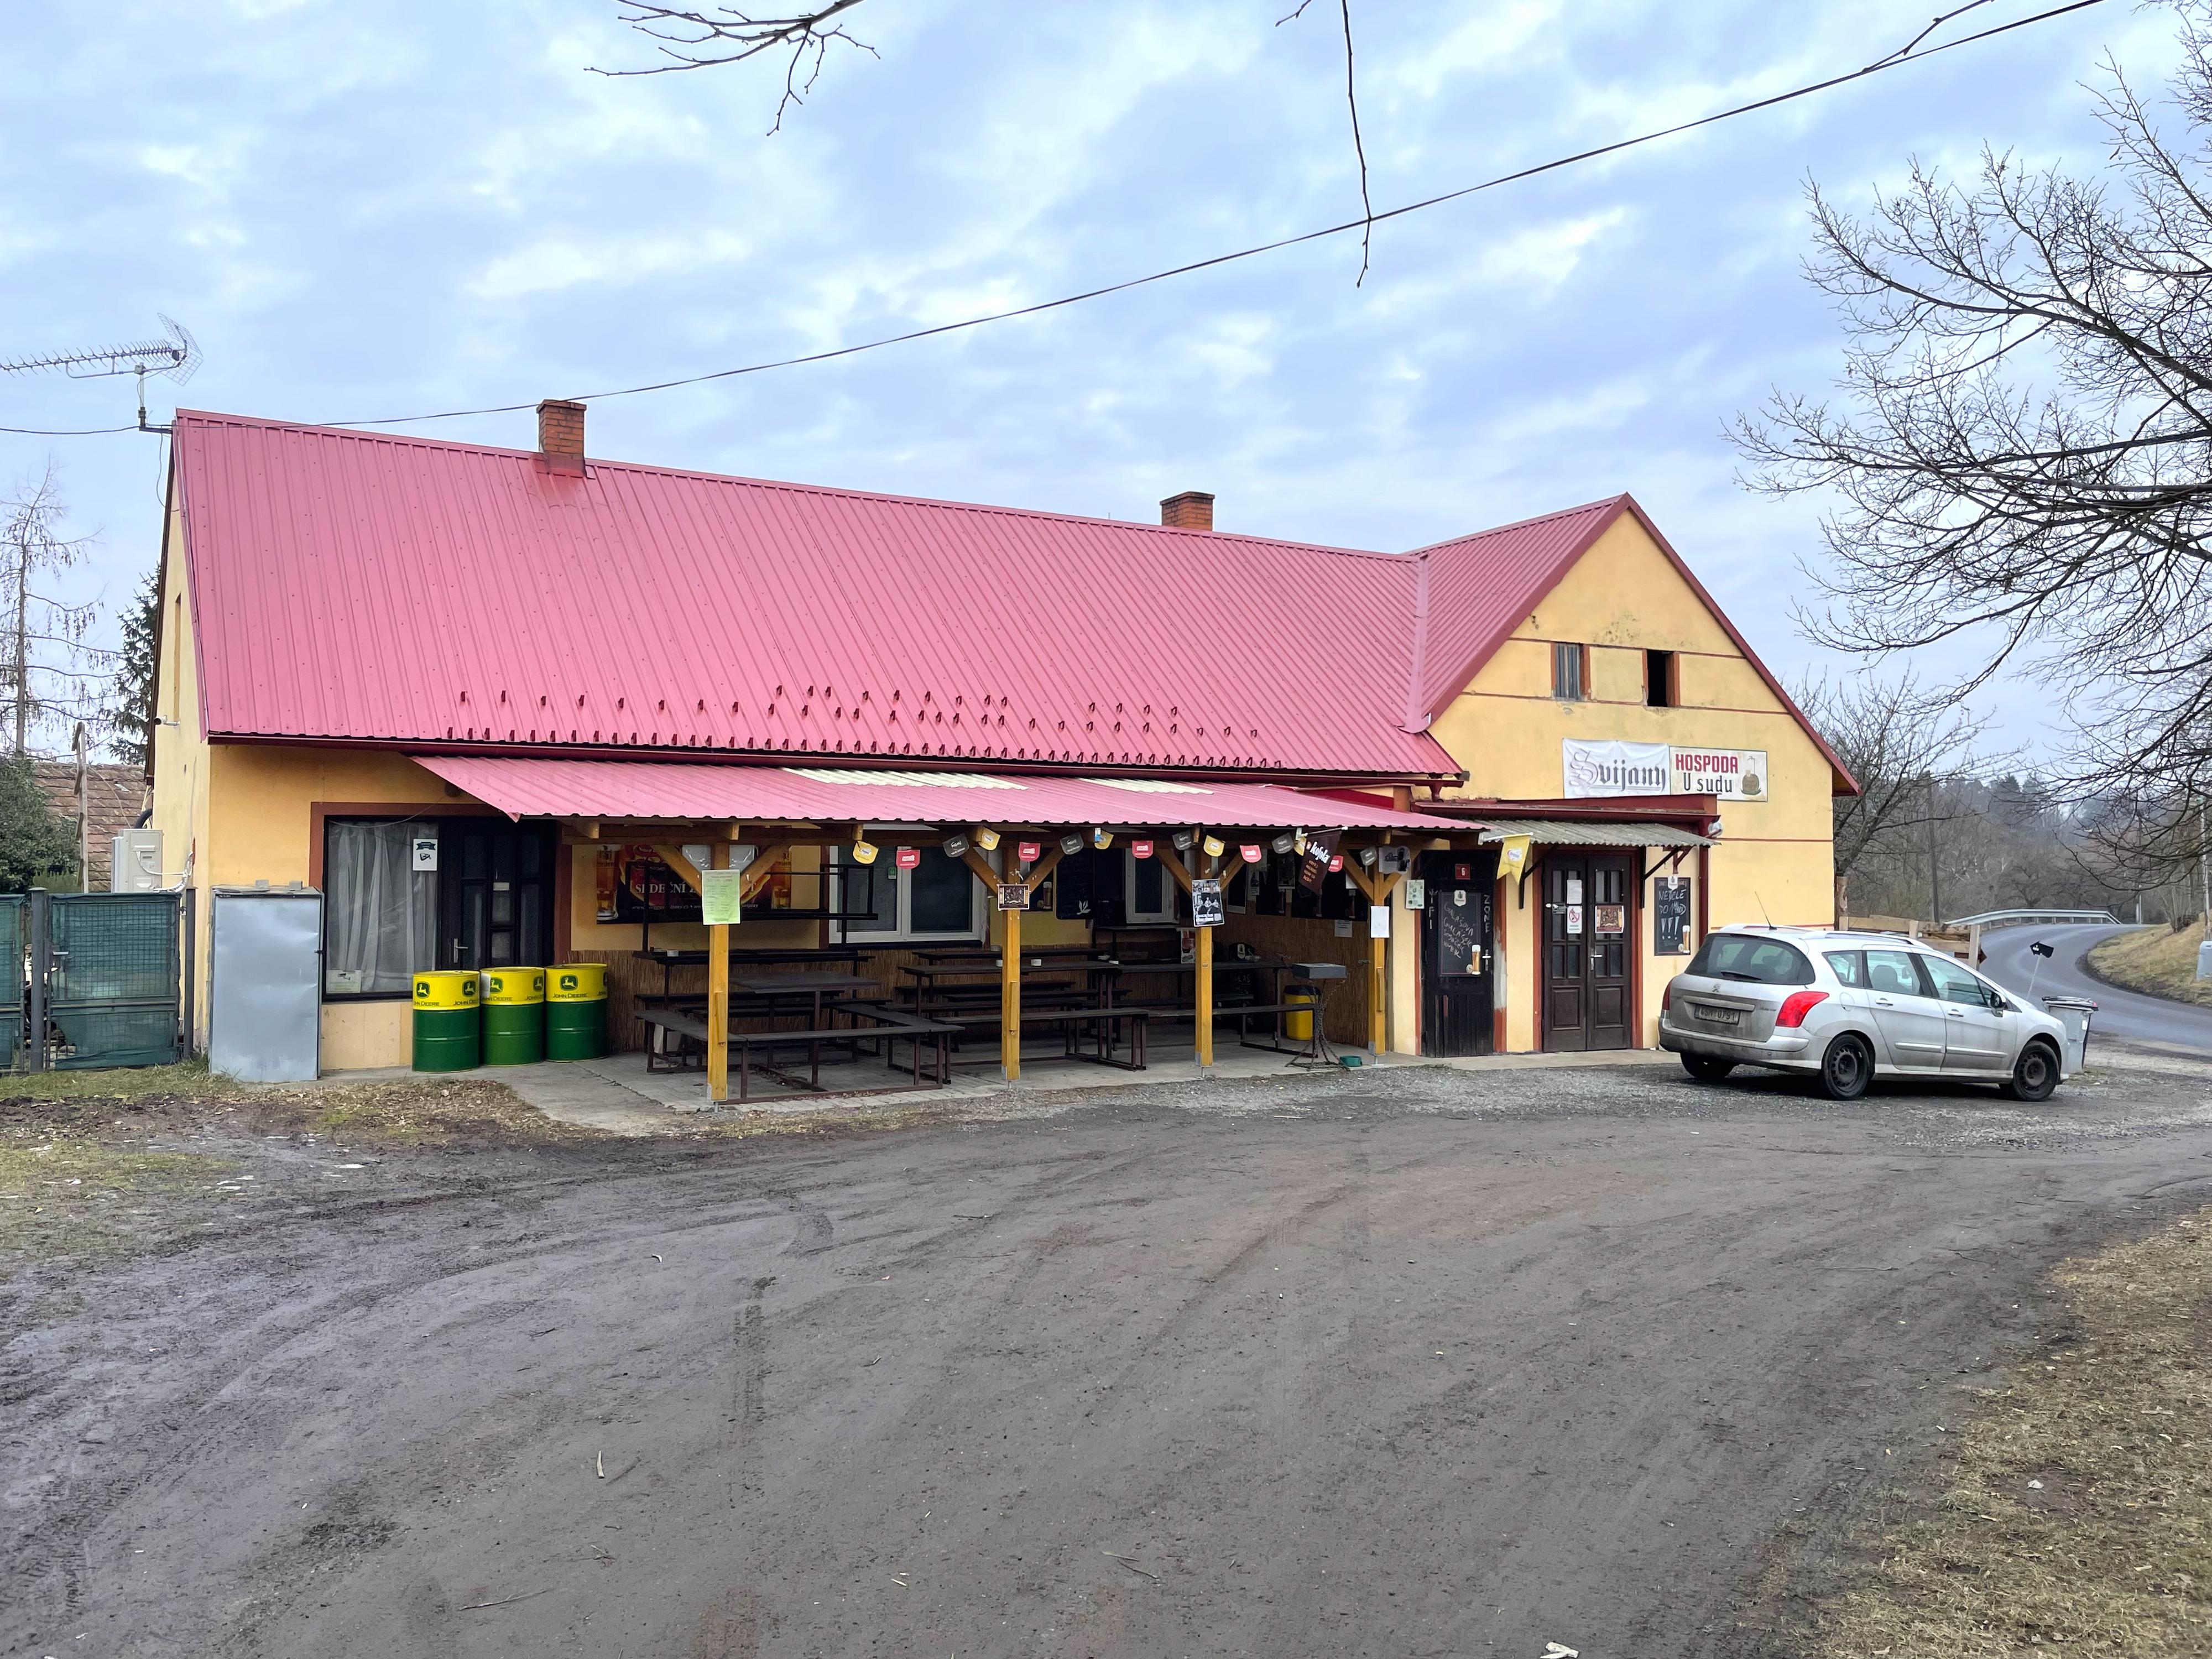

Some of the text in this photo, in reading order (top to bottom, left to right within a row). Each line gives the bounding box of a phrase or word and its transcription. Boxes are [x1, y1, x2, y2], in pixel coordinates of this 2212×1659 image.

[1569, 748, 1665, 793] Svijany
[1676, 753, 1739, 774] HOSPODA
[1683, 773, 1733, 793] U sudu
[1717, 1010, 1735, 1021] 0791
